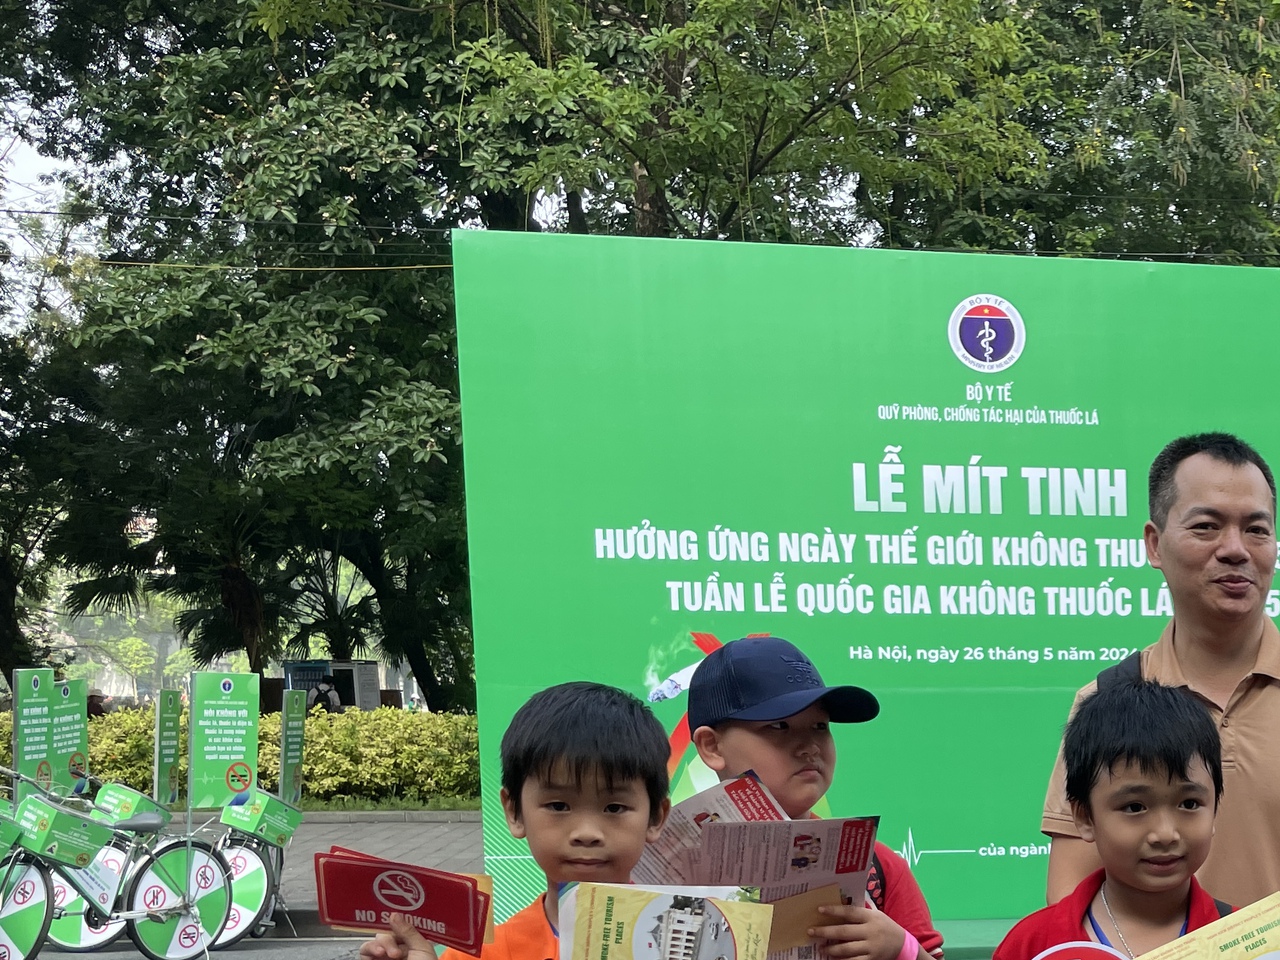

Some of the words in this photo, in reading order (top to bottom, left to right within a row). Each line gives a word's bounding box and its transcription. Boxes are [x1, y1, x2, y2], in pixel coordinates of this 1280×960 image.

[966, 382, 983, 404] BỘ
[985, 386, 995, 400] Y
[997, 381, 1014, 402] TẾ
[878, 404, 900, 420] QUỸ
[902, 405, 942, 423] PHÒNG,
[944, 404, 980, 422] CHỐNG
[982, 406, 1003, 422] TÁC
[1005, 408, 1023, 425] HẠI
[1025, 406, 1047, 424] CỦA
[1049, 406, 1083, 425] THUỐC
[1085, 409, 1099, 425] LÁ
[852, 444, 907, 513] LỄ
[922, 455, 1008, 515] MÍT
[1020, 466, 1128, 517] TINH
[595, 519, 698, 561] HƯỞNG
[708, 525, 769, 562] ỨNG
[779, 526, 856, 563] NGÀY
[865, 525, 919, 565] THẾ
[926, 530, 983, 566] GIỚI
[992, 531, 1087, 567] KHÔNG
[1095, 538, 1152, 568] THU
[666, 571, 744, 612] TUẦN
[754, 572, 788, 613] LỄ
[797, 573, 874, 617] QUỐC
[883, 584, 932, 615] GIA
[940, 580, 1035, 617] KHÔNG
[1043, 577, 1132, 617] THUỐC
[1141, 583, 1174, 617] LÁ
[849, 645, 872, 660] Hà
[876, 645, 912, 663] Nội,
[916, 646, 959, 664] ngày
[963, 648, 984, 660] 26
[988, 646, 1039, 664] tháng
[1043, 648, 1053, 660] 5
[1057, 647, 1095, 661] năm
[979, 844, 1006, 857] của
[603, 894, 614, 925] TOURISM
[354, 909, 376, 923] NO
[380, 911, 446, 935] SOKING
[614, 920, 624, 945] PLACES
[1221, 932, 1253, 951] SMOKE-FREE
[1245, 937, 1266, 951] PLACES
